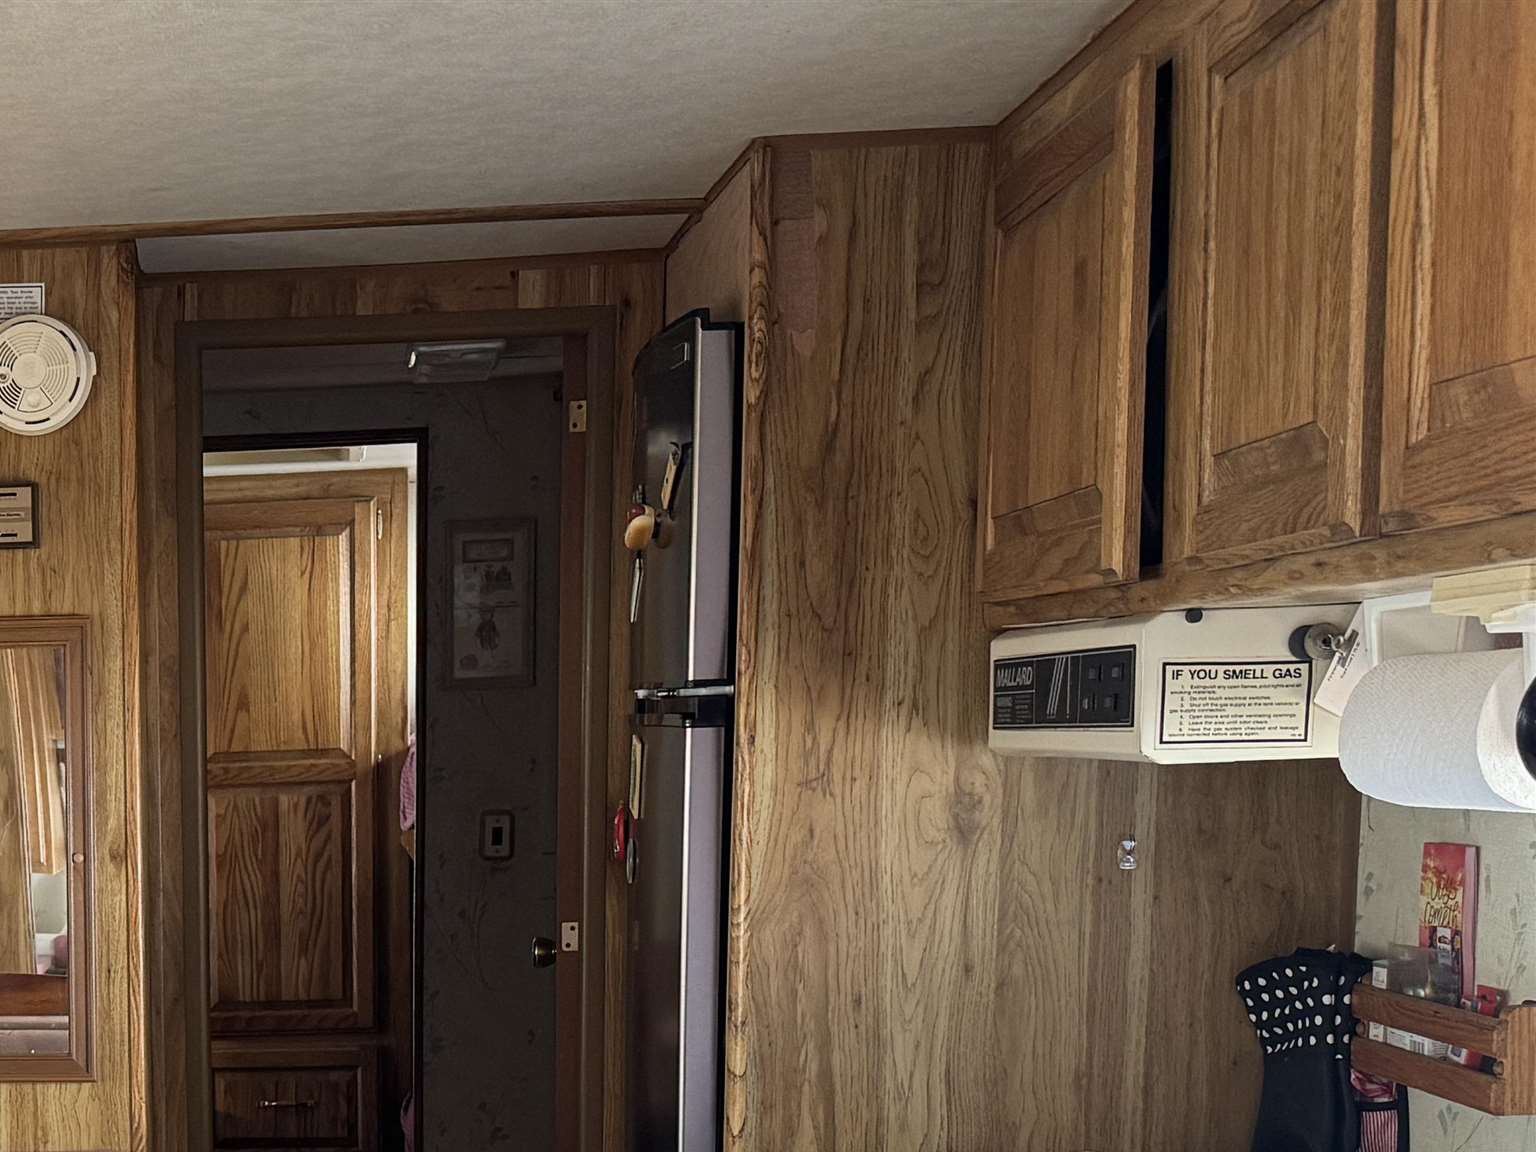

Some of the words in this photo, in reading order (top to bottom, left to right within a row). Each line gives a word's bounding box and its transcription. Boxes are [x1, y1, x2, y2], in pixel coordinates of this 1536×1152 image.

[996, 666, 1033, 688] MALLARD
[1171, 669, 1184, 681] IF
[1189, 669, 1218, 680] YOU
[1223, 668, 1268, 680] SMELL
[1272, 667, 1302, 679] GAS
